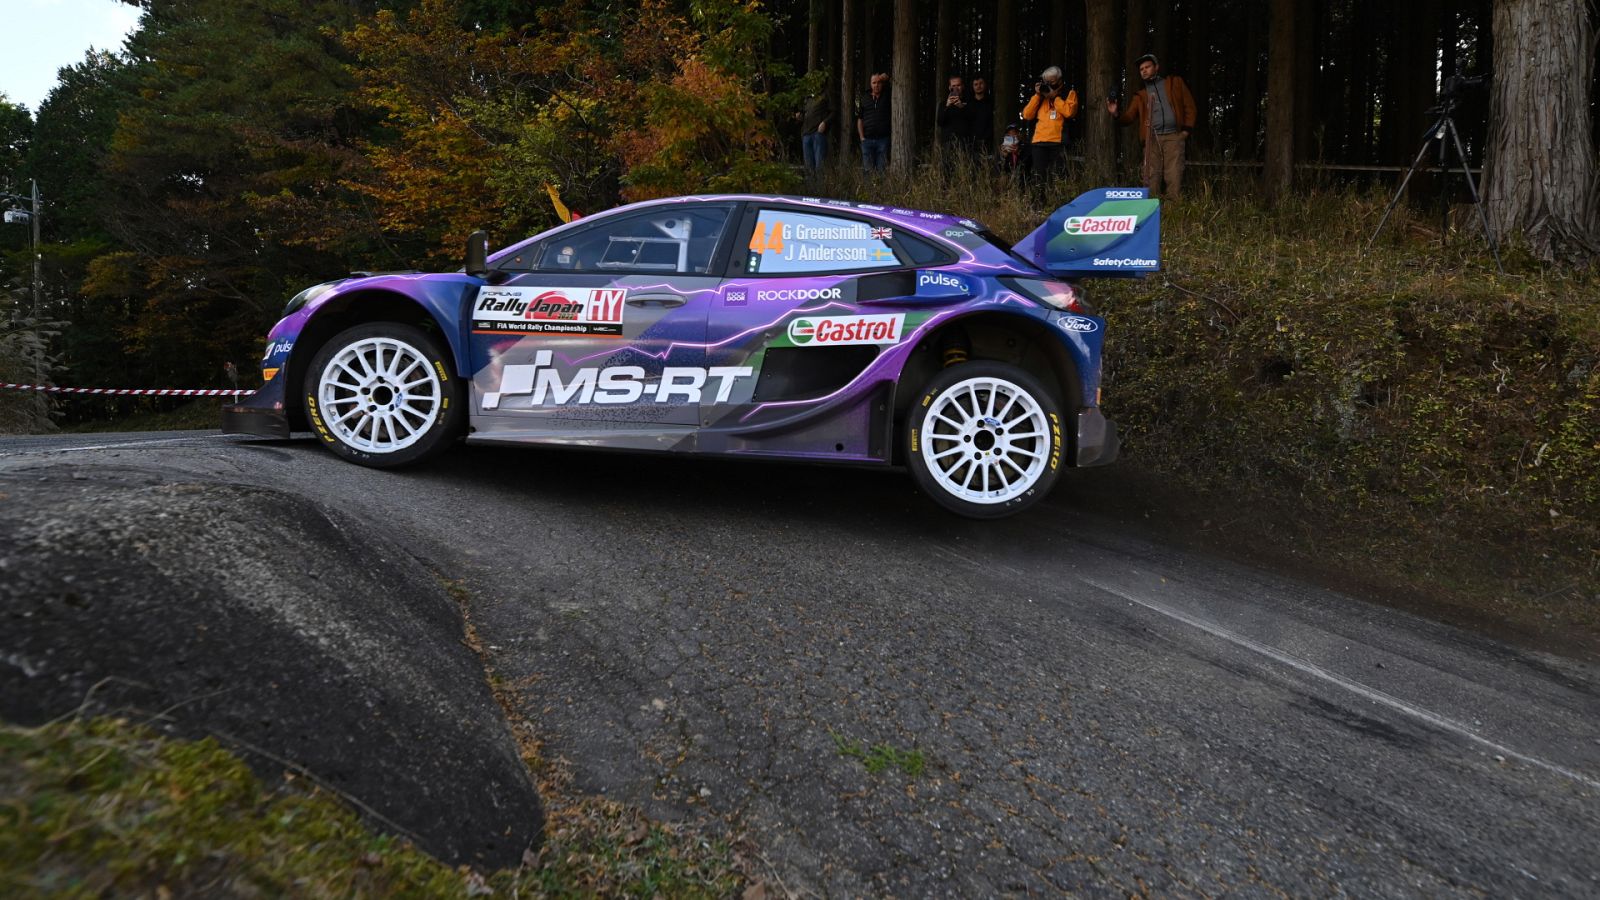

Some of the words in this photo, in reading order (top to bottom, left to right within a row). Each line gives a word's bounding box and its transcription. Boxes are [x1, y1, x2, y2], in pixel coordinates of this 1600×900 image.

[1105, 190, 1143, 199] sparco
[782, 225, 792, 240] G
[796, 224, 867, 240] Greensmith
[1082, 217, 1132, 233] Castrol
[749, 221, 784, 255] 44
[784, 244, 793, 262] J
[799, 244, 867, 262] Andersson
[1093, 258, 1157, 267] SafetyCulture
[919, 273, 959, 287] pulse
[757, 288, 841, 301] ROCKDOOR
[478, 298, 529, 316] Rally
[528, 298, 584, 318] Japan
[587, 290, 624, 320] HY
[509, 323, 526, 331] World
[527, 323, 543, 332] Rally
[544, 324, 588, 333] Championship
[815, 317, 896, 343] Castrol
[1064, 318, 1092, 331] Ford
[531, 366, 753, 405] MS-RT
